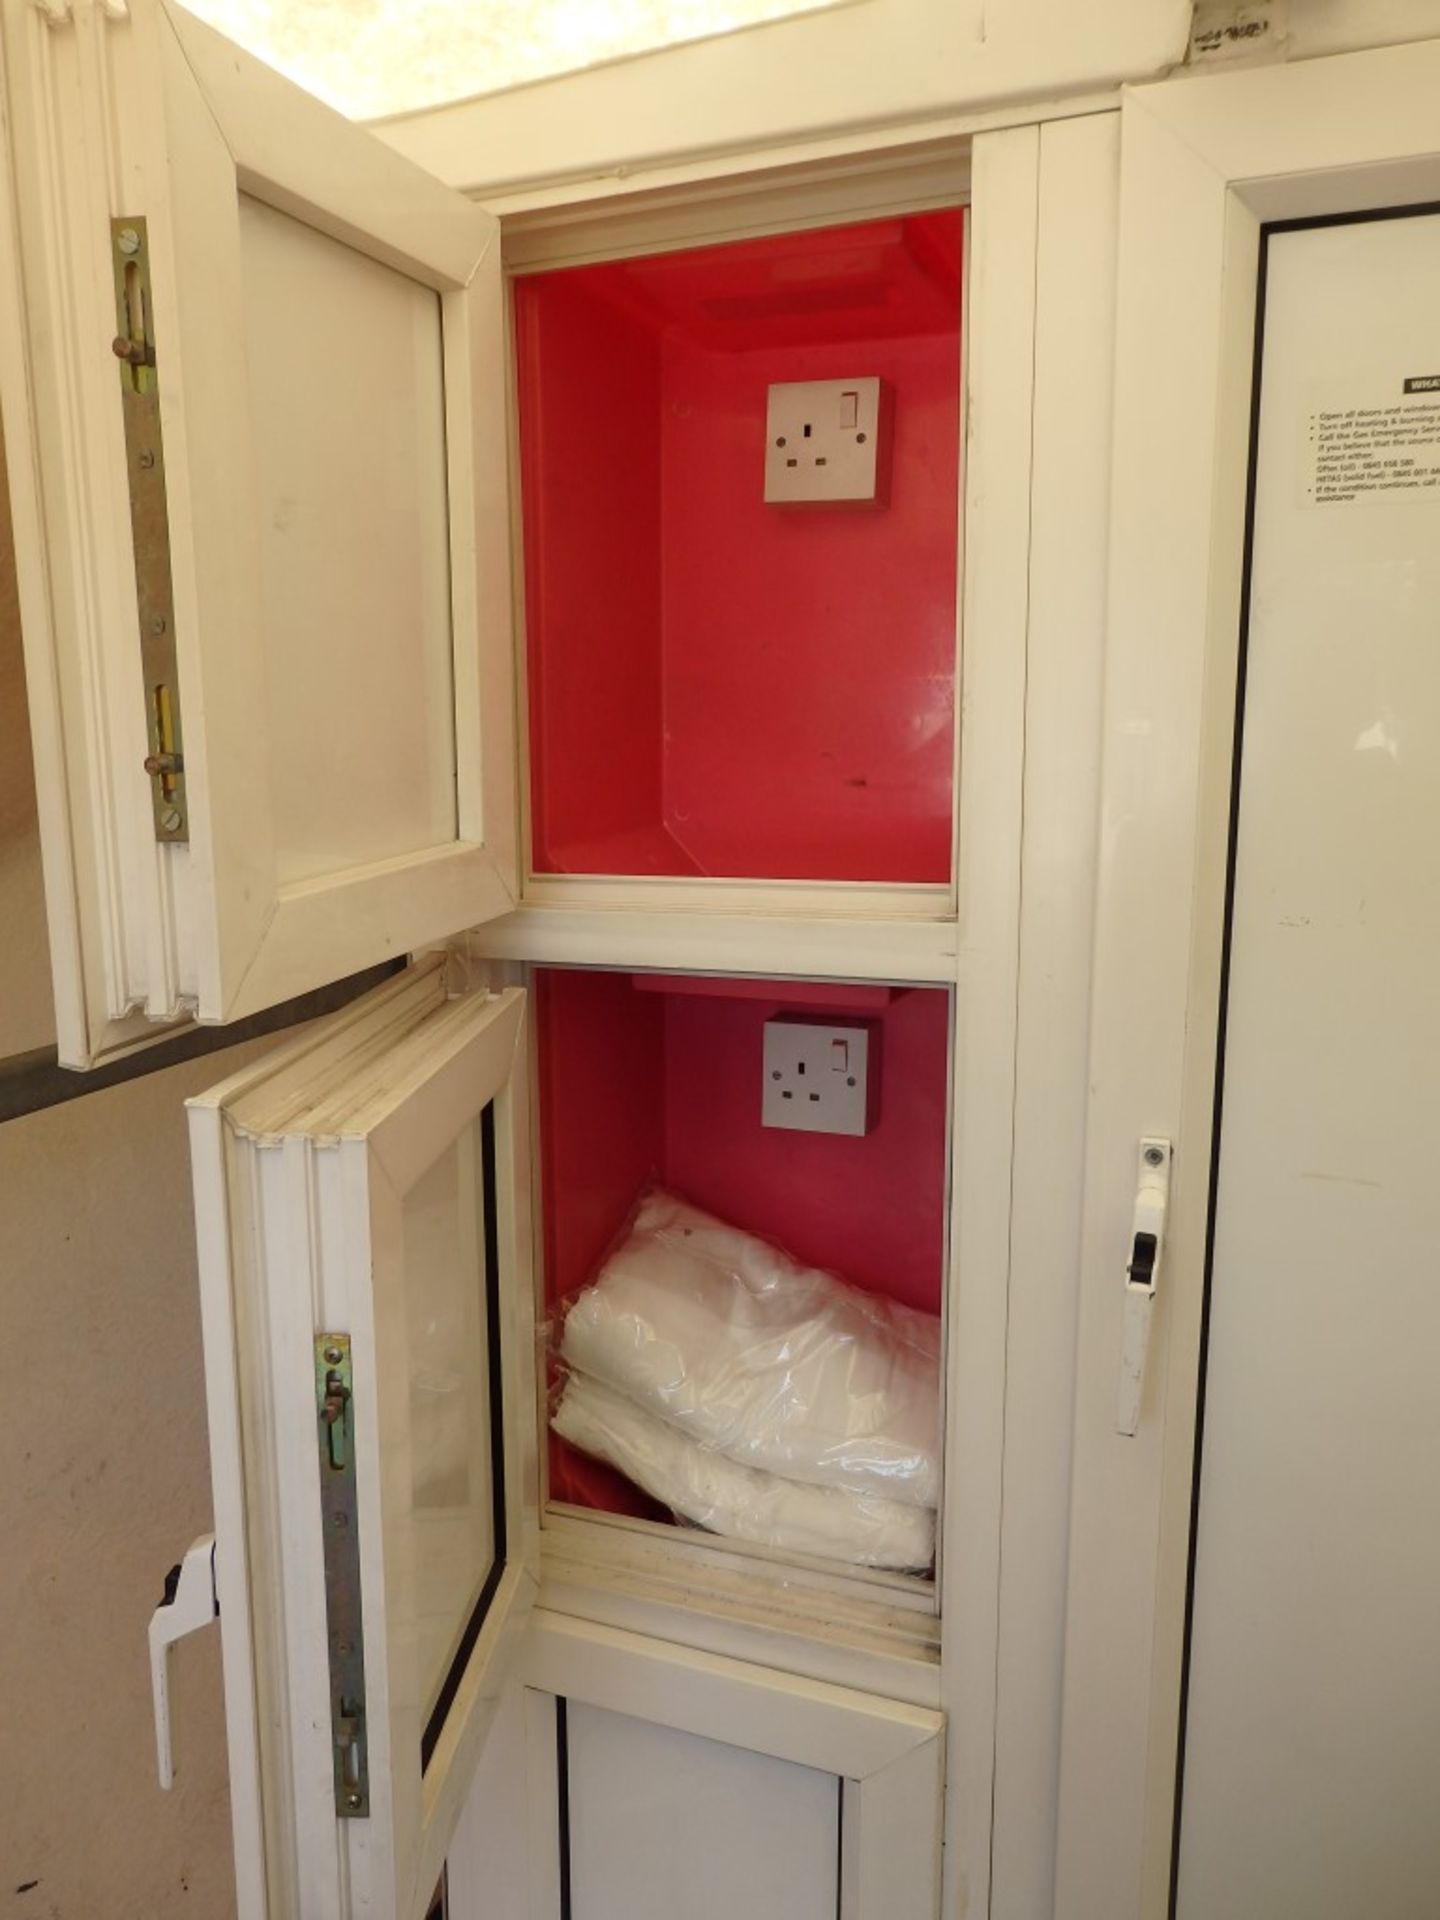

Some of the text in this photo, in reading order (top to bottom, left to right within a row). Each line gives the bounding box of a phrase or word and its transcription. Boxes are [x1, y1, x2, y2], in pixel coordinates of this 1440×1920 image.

[1320, 412, 1343, 421] Open
[1345, 410, 1356, 418] all
[1384, 406, 1401, 415] and
[1340, 421, 1352, 430] off
[1355, 419, 1388, 428] heating
[1400, 416, 1435, 424] burning
[1353, 430, 1369, 439] Gas
[1371, 428, 1418, 438] Emergency
[1408, 437, 1434, 445] source
[1317, 454, 1346, 462] contact
[1339, 483, 1377, 492] condition
[1316, 494, 1355, 502] assistance
